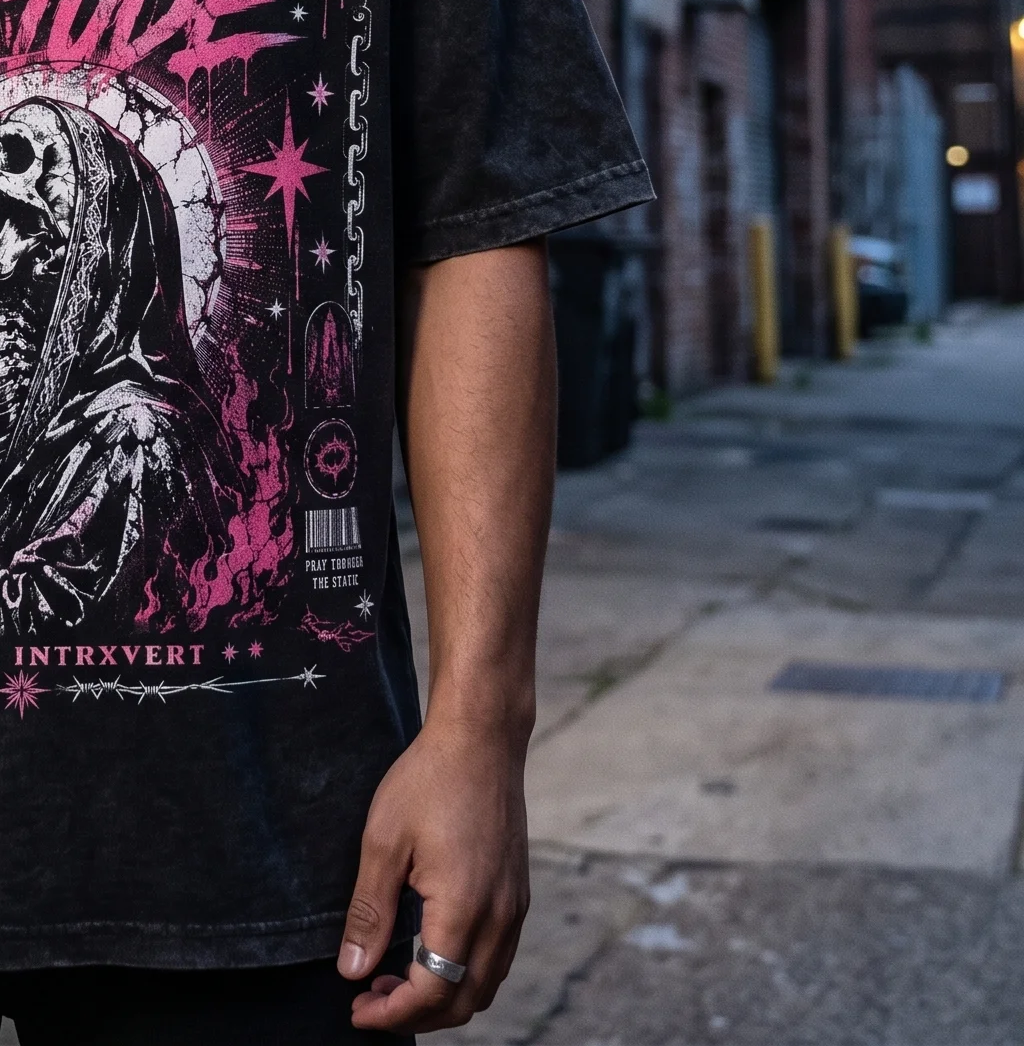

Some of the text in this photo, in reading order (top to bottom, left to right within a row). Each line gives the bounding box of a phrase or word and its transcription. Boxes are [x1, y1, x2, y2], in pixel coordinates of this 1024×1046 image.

[305, 559, 327, 572] PRAY
[312, 574, 359, 590] THE STATIC
[14, 644, 205, 666] INTRXVERT
